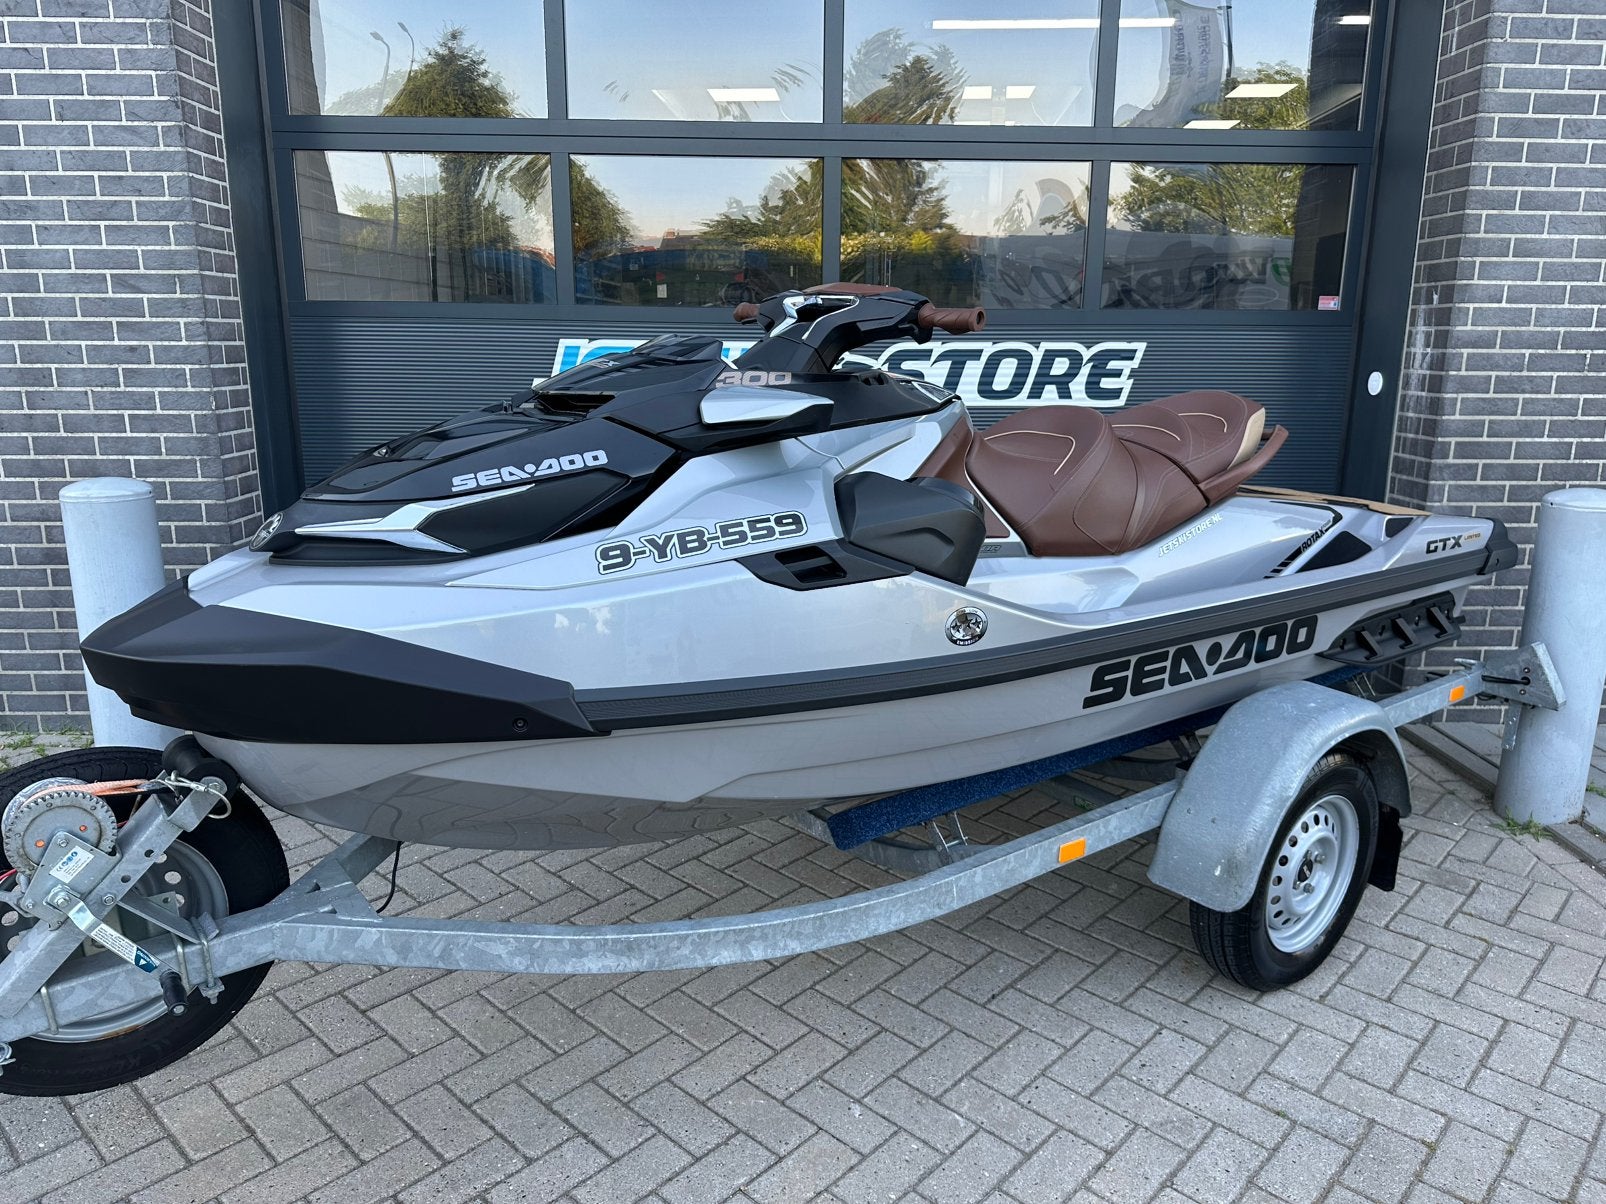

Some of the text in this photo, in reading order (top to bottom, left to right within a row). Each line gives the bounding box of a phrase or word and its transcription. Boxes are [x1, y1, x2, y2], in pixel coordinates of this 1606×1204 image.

[715, 371, 792, 388] 300
[595, 510, 808, 575] 9-YB-559
[1301, 527, 1326, 553] ROTAX
[1426, 534, 1463, 554] GTX
